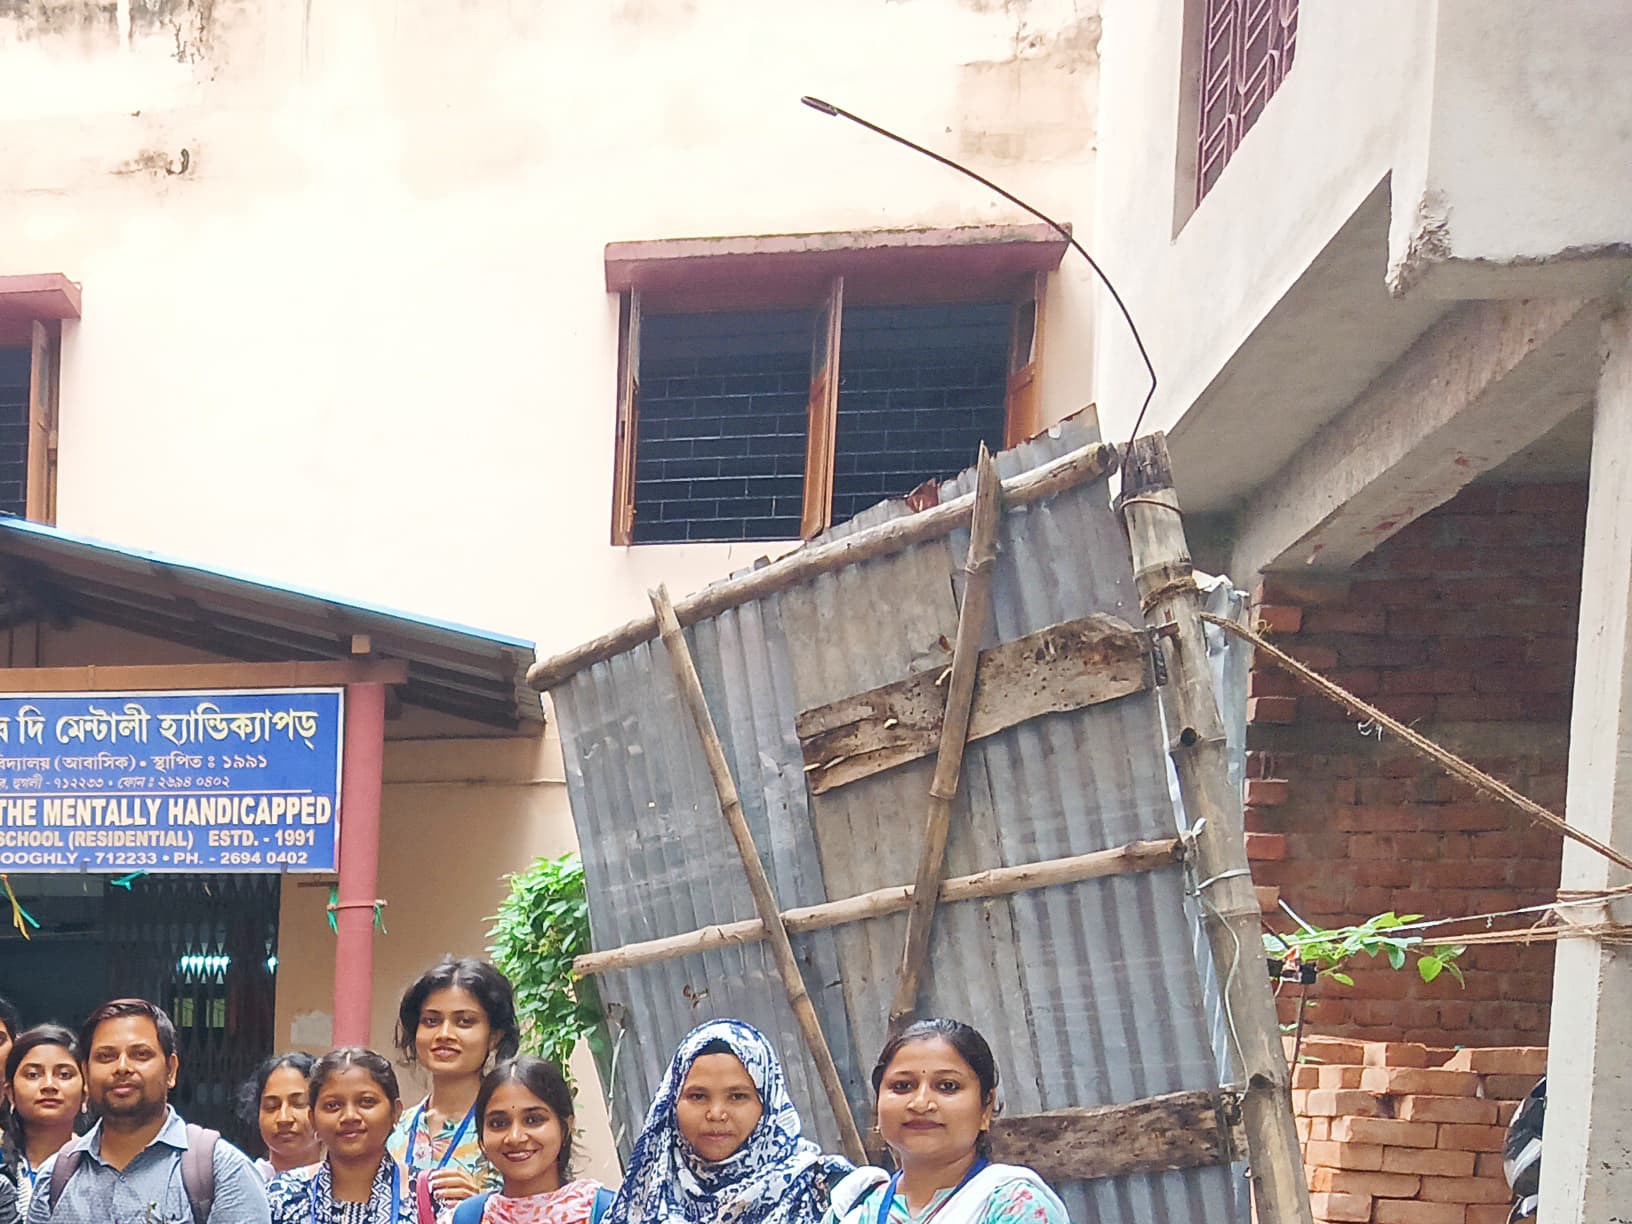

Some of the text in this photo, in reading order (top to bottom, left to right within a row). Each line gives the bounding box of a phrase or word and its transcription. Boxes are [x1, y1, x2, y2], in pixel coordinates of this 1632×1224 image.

[16, 706, 46, 744] দি
[55, 703, 151, 745] মেন্টালী
[54, 752, 137, 772] (আবাসিক)
[151, 751, 202, 773] স্থাপিত
[222, 755, 268, 769] ১৯৯১
[54, 777, 104, 789] ৭১২২৩৩
[196, 775, 230, 788] ০৪০২
[42, 798, 162, 827] MENTALLY
[168, 796, 331, 826] HANDICAPPED
[68, 829, 194, 849] (RESIDENTIAL)
[208, 829, 259, 847] ESTD.
[274, 829, 316, 846] 1991
[95, 852, 158, 865] 712233
[174, 852, 204, 864] PH.
[220, 852, 262, 864] 2694
[266, 852, 308, 864] 0402
